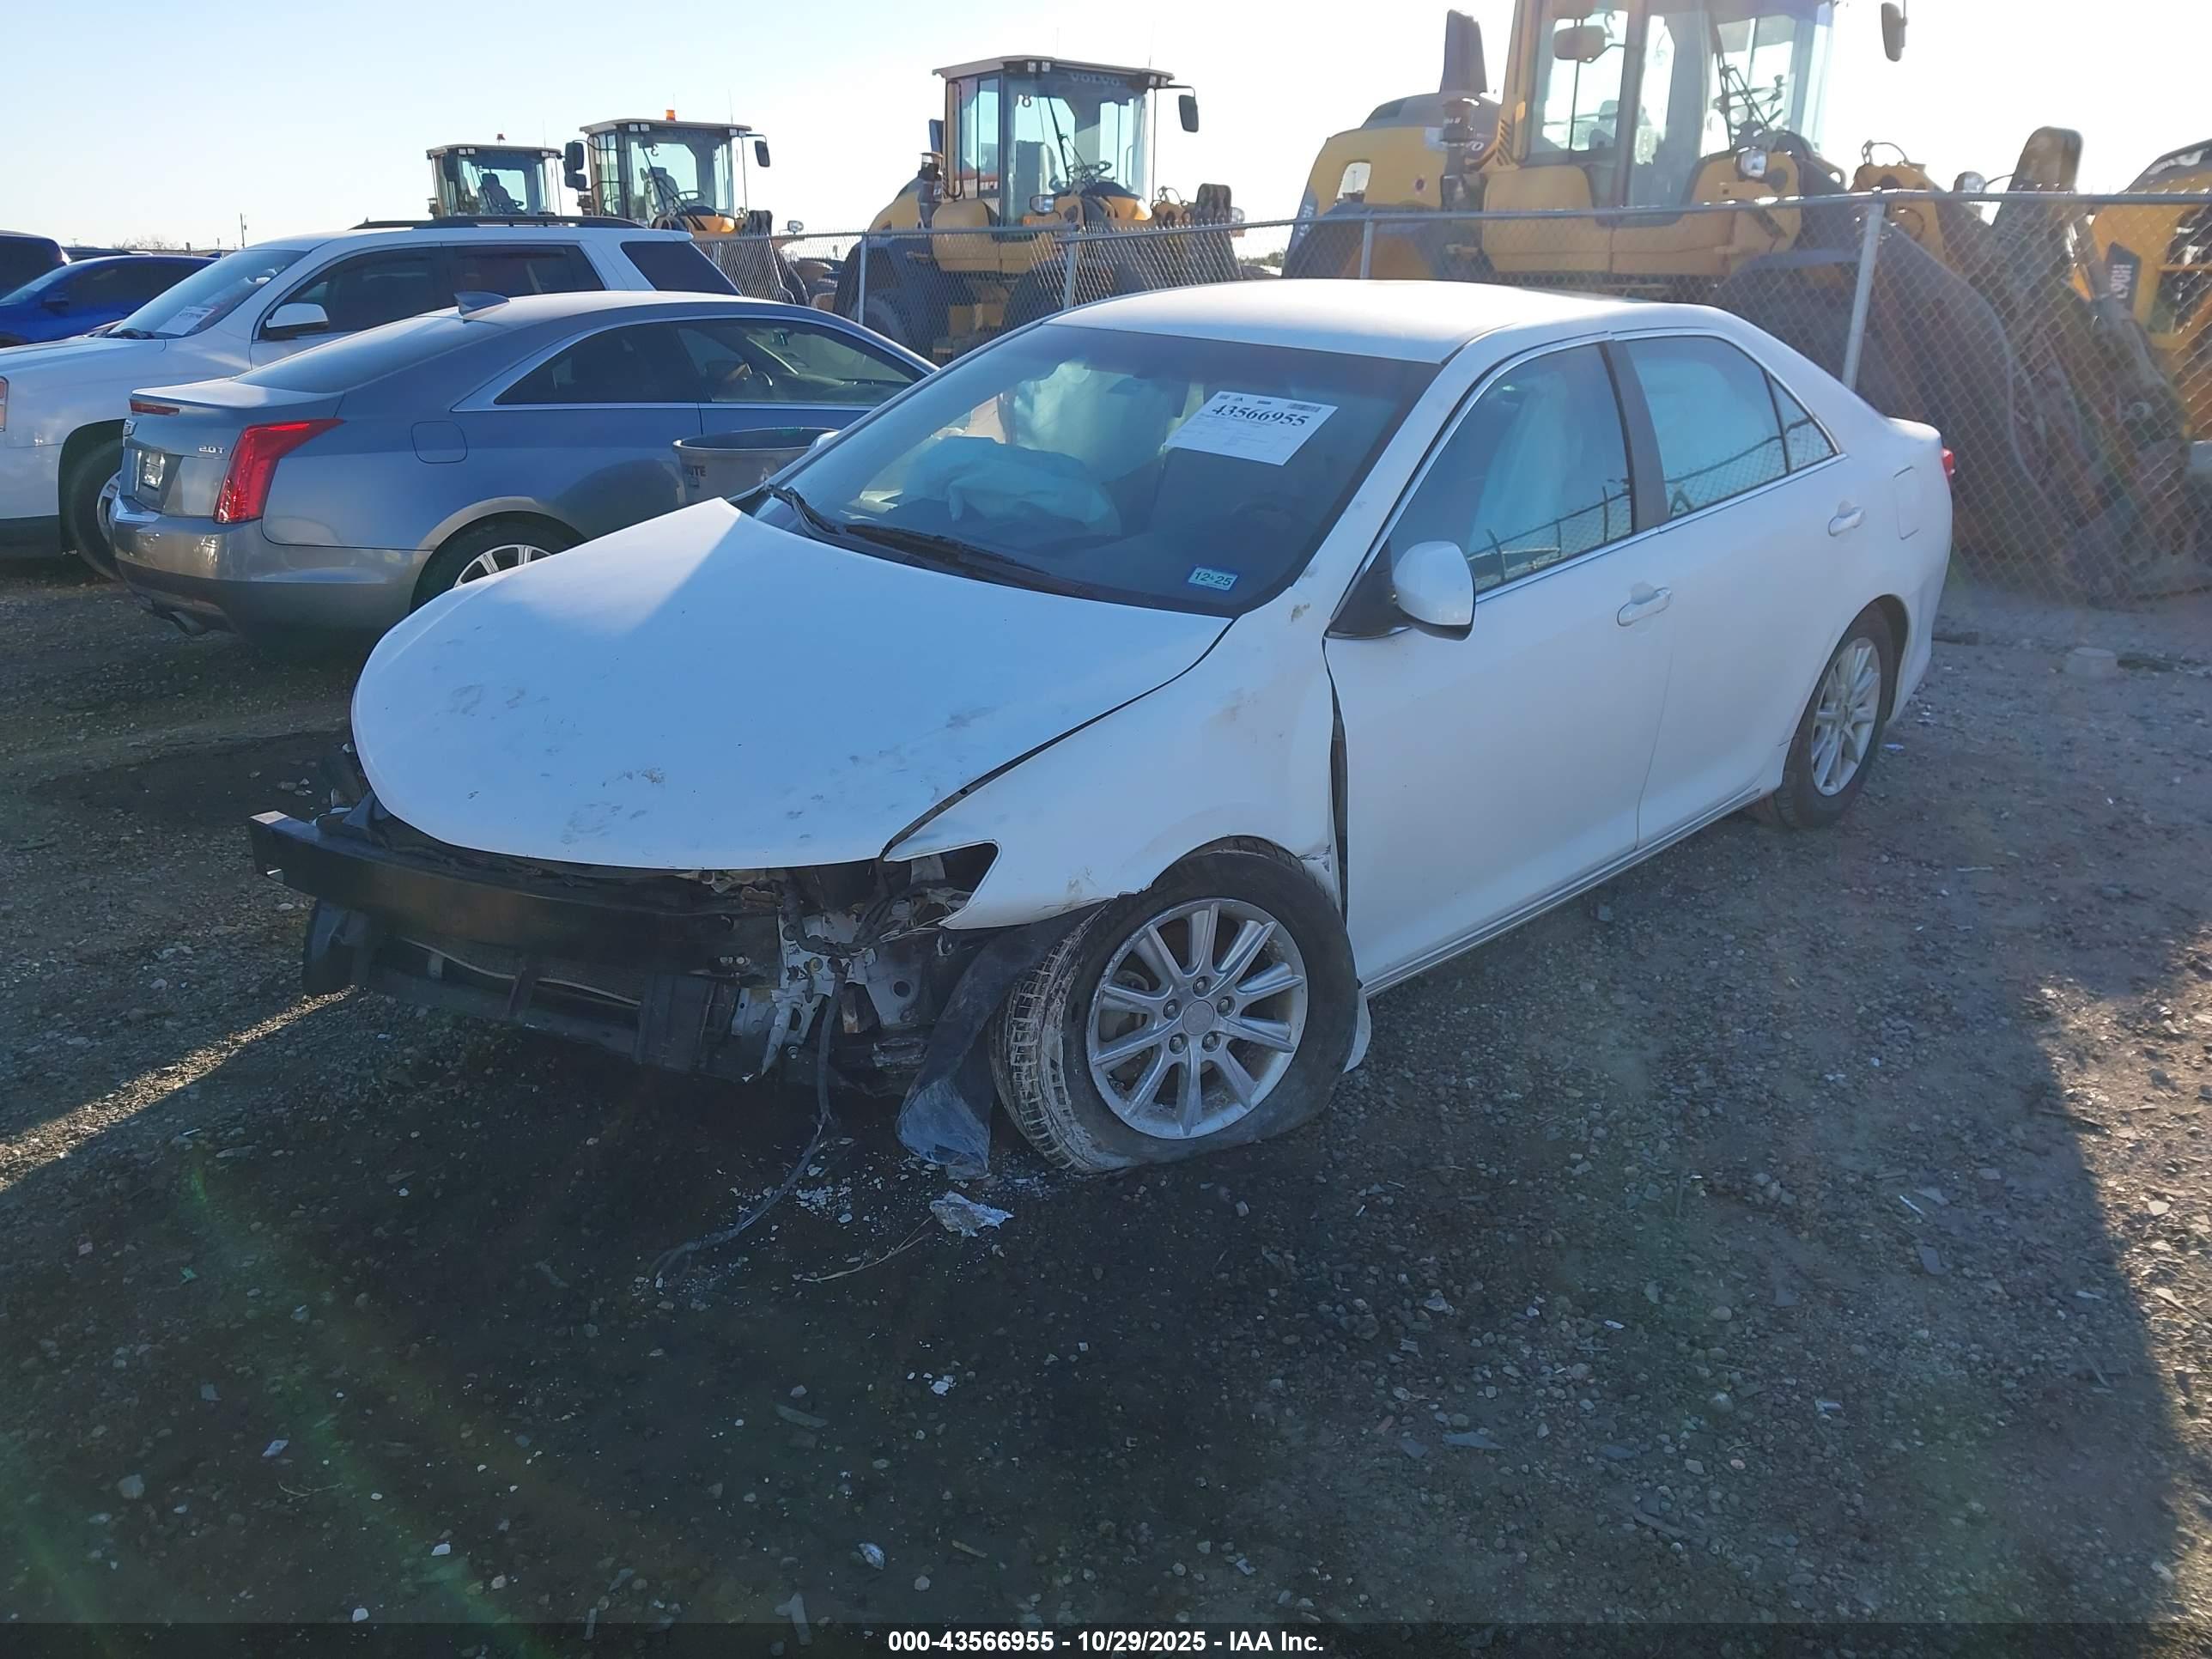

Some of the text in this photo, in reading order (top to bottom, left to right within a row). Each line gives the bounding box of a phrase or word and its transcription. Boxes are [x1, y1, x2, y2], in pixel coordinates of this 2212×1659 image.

[1070, 73, 1120, 86] VOLVO
[2110, 264, 2133, 299] L90H
[1212, 404, 1310, 427] 43566955
